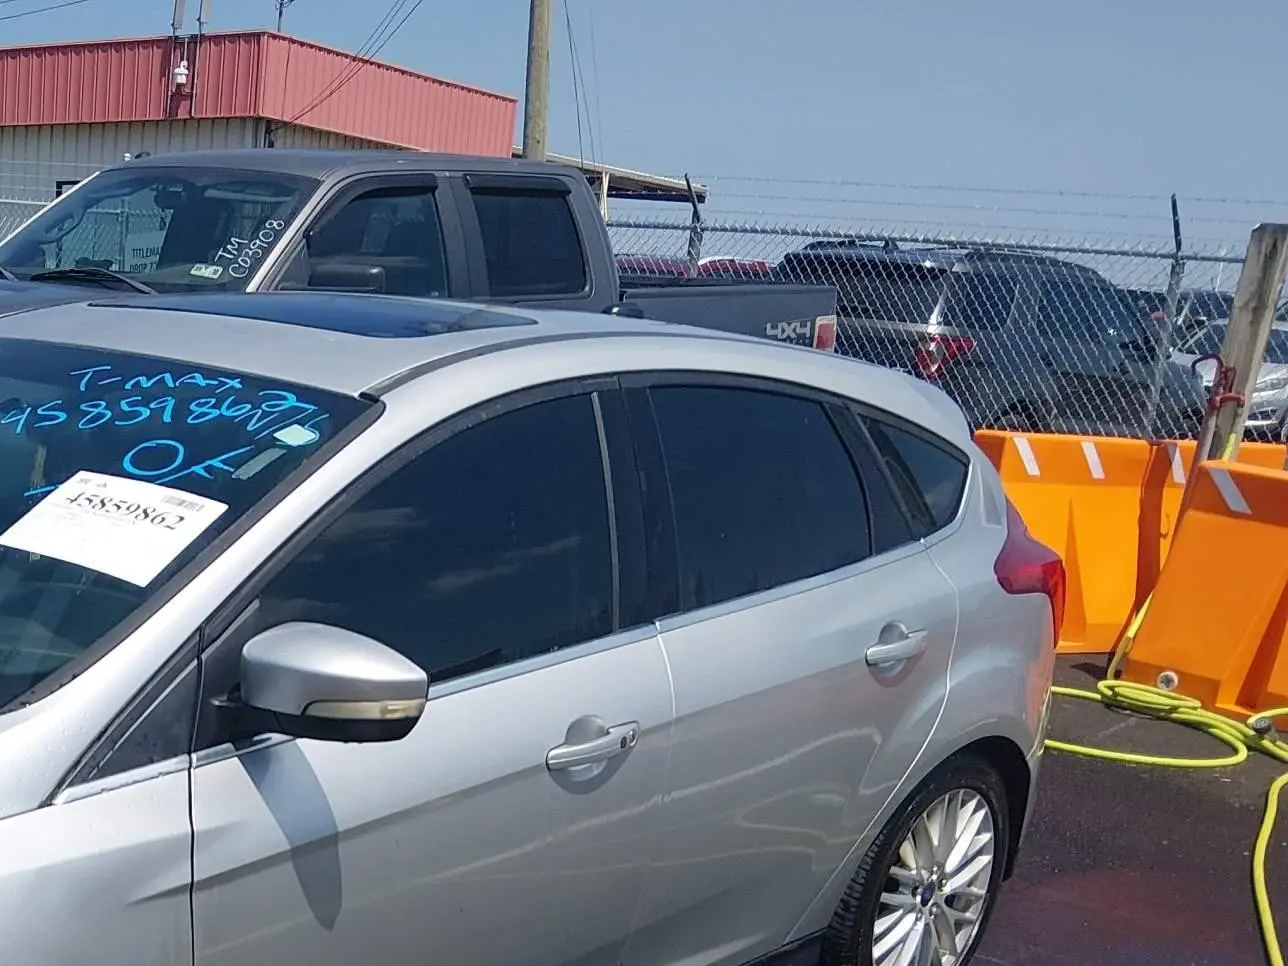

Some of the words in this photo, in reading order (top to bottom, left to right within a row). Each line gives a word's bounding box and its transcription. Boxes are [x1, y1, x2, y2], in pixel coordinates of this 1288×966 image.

[132, 246, 160, 258] TITLEMA
[214, 236, 249, 262] TM
[766, 321, 811, 339] 4X4
[65, 491, 185, 530] 45859862
